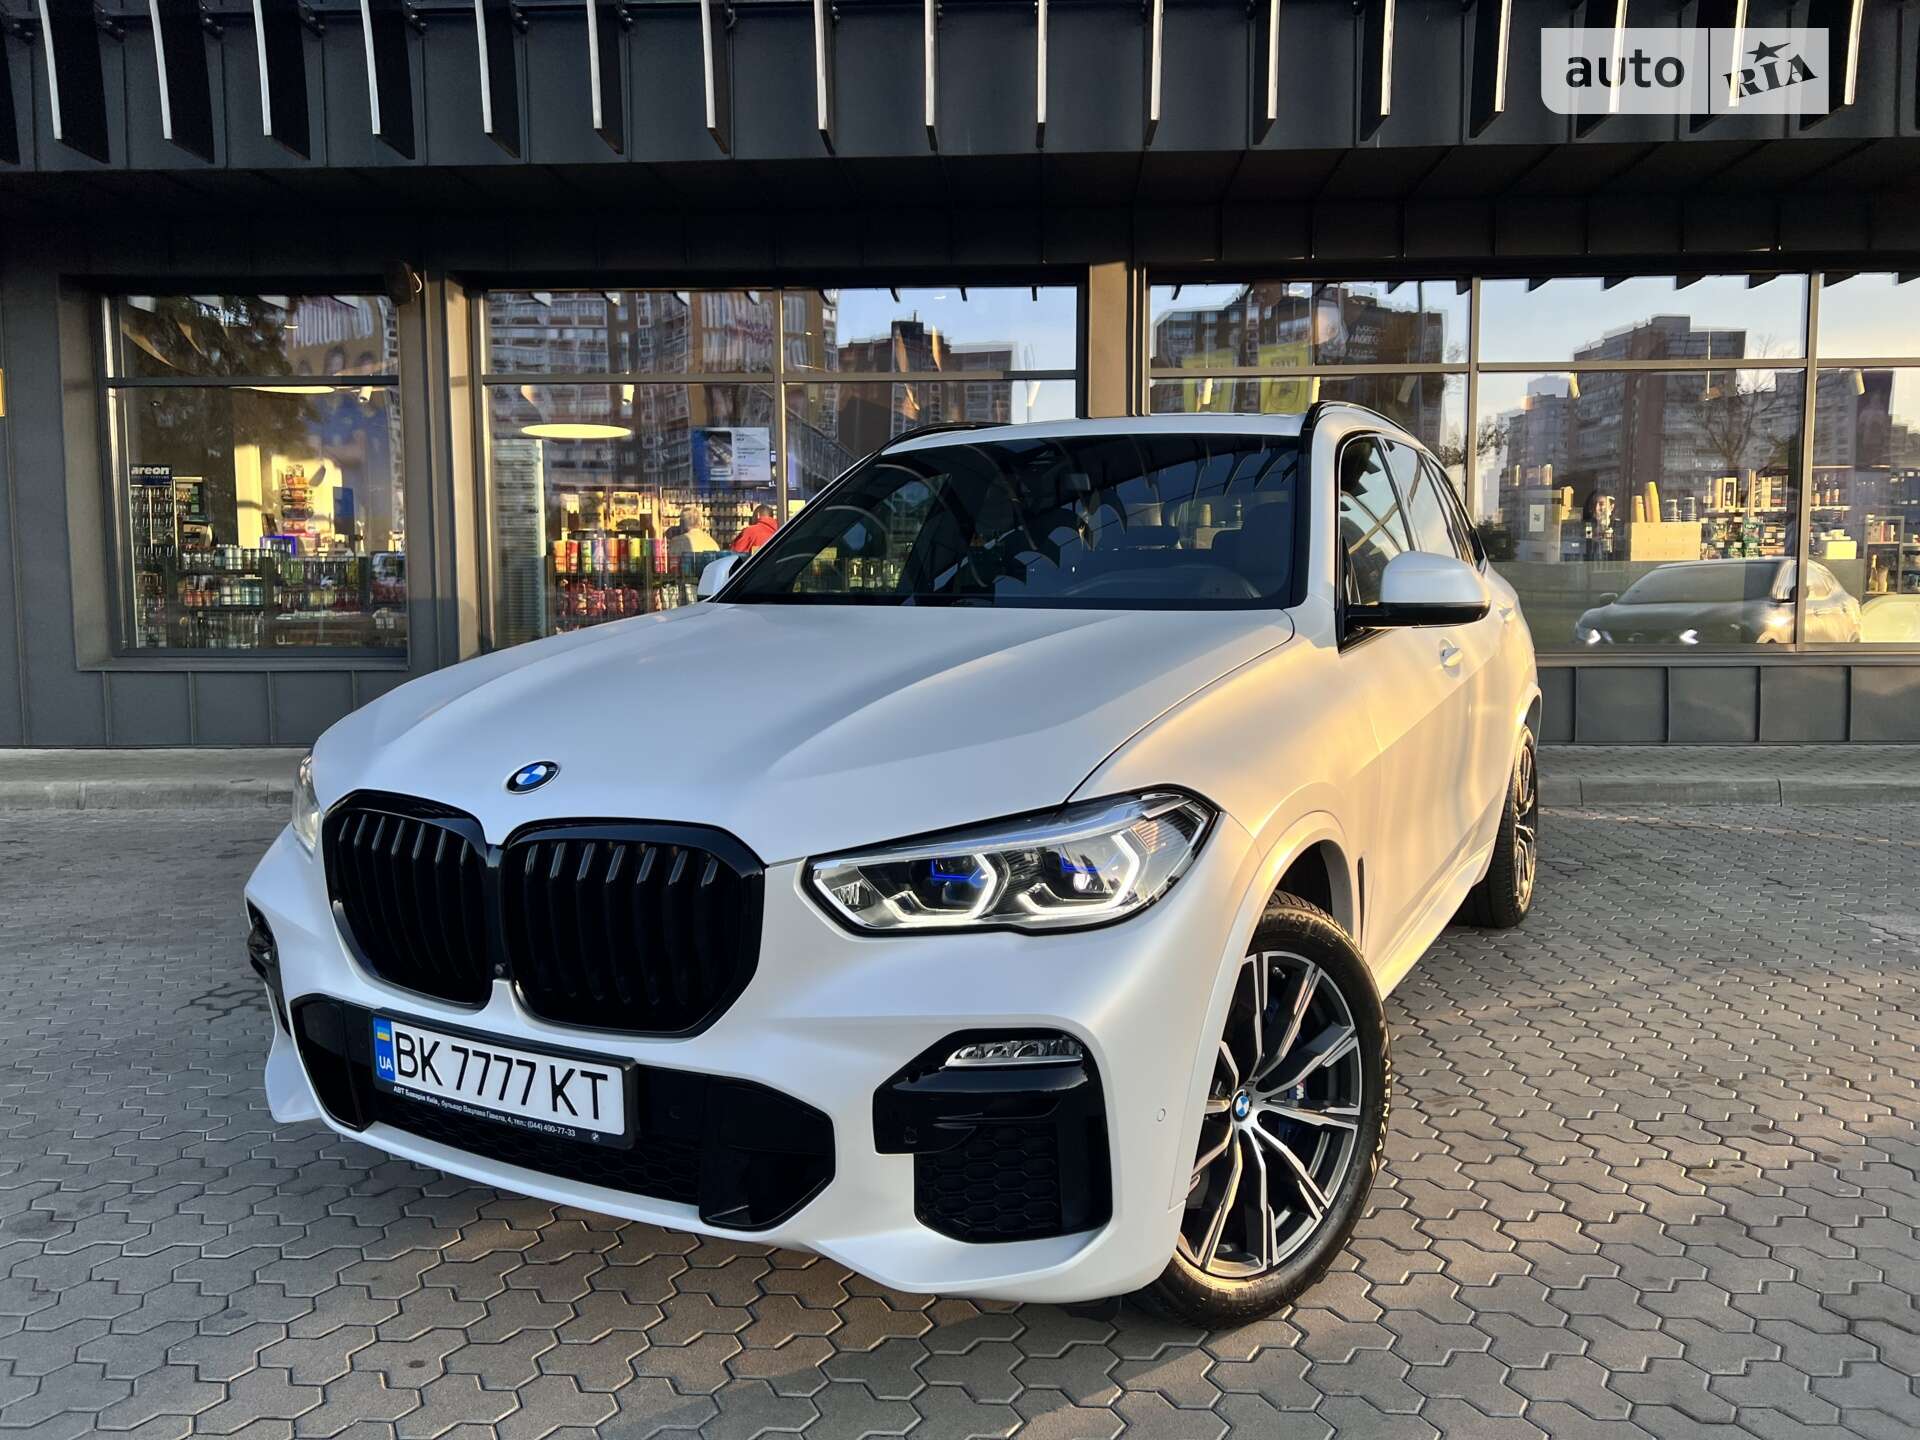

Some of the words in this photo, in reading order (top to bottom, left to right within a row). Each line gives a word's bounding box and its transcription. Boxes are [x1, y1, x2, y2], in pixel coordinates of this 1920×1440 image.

[131, 466, 170, 475] areon
[379, 1055, 393, 1072] UA
[395, 1031, 443, 1087] BK
[451, 1045, 537, 1106] 7777
[549, 1065, 608, 1120] KT
[1376, 1059, 1391, 1152] ALENZA
[543, 1125, 576, 1137] 490-77-33
